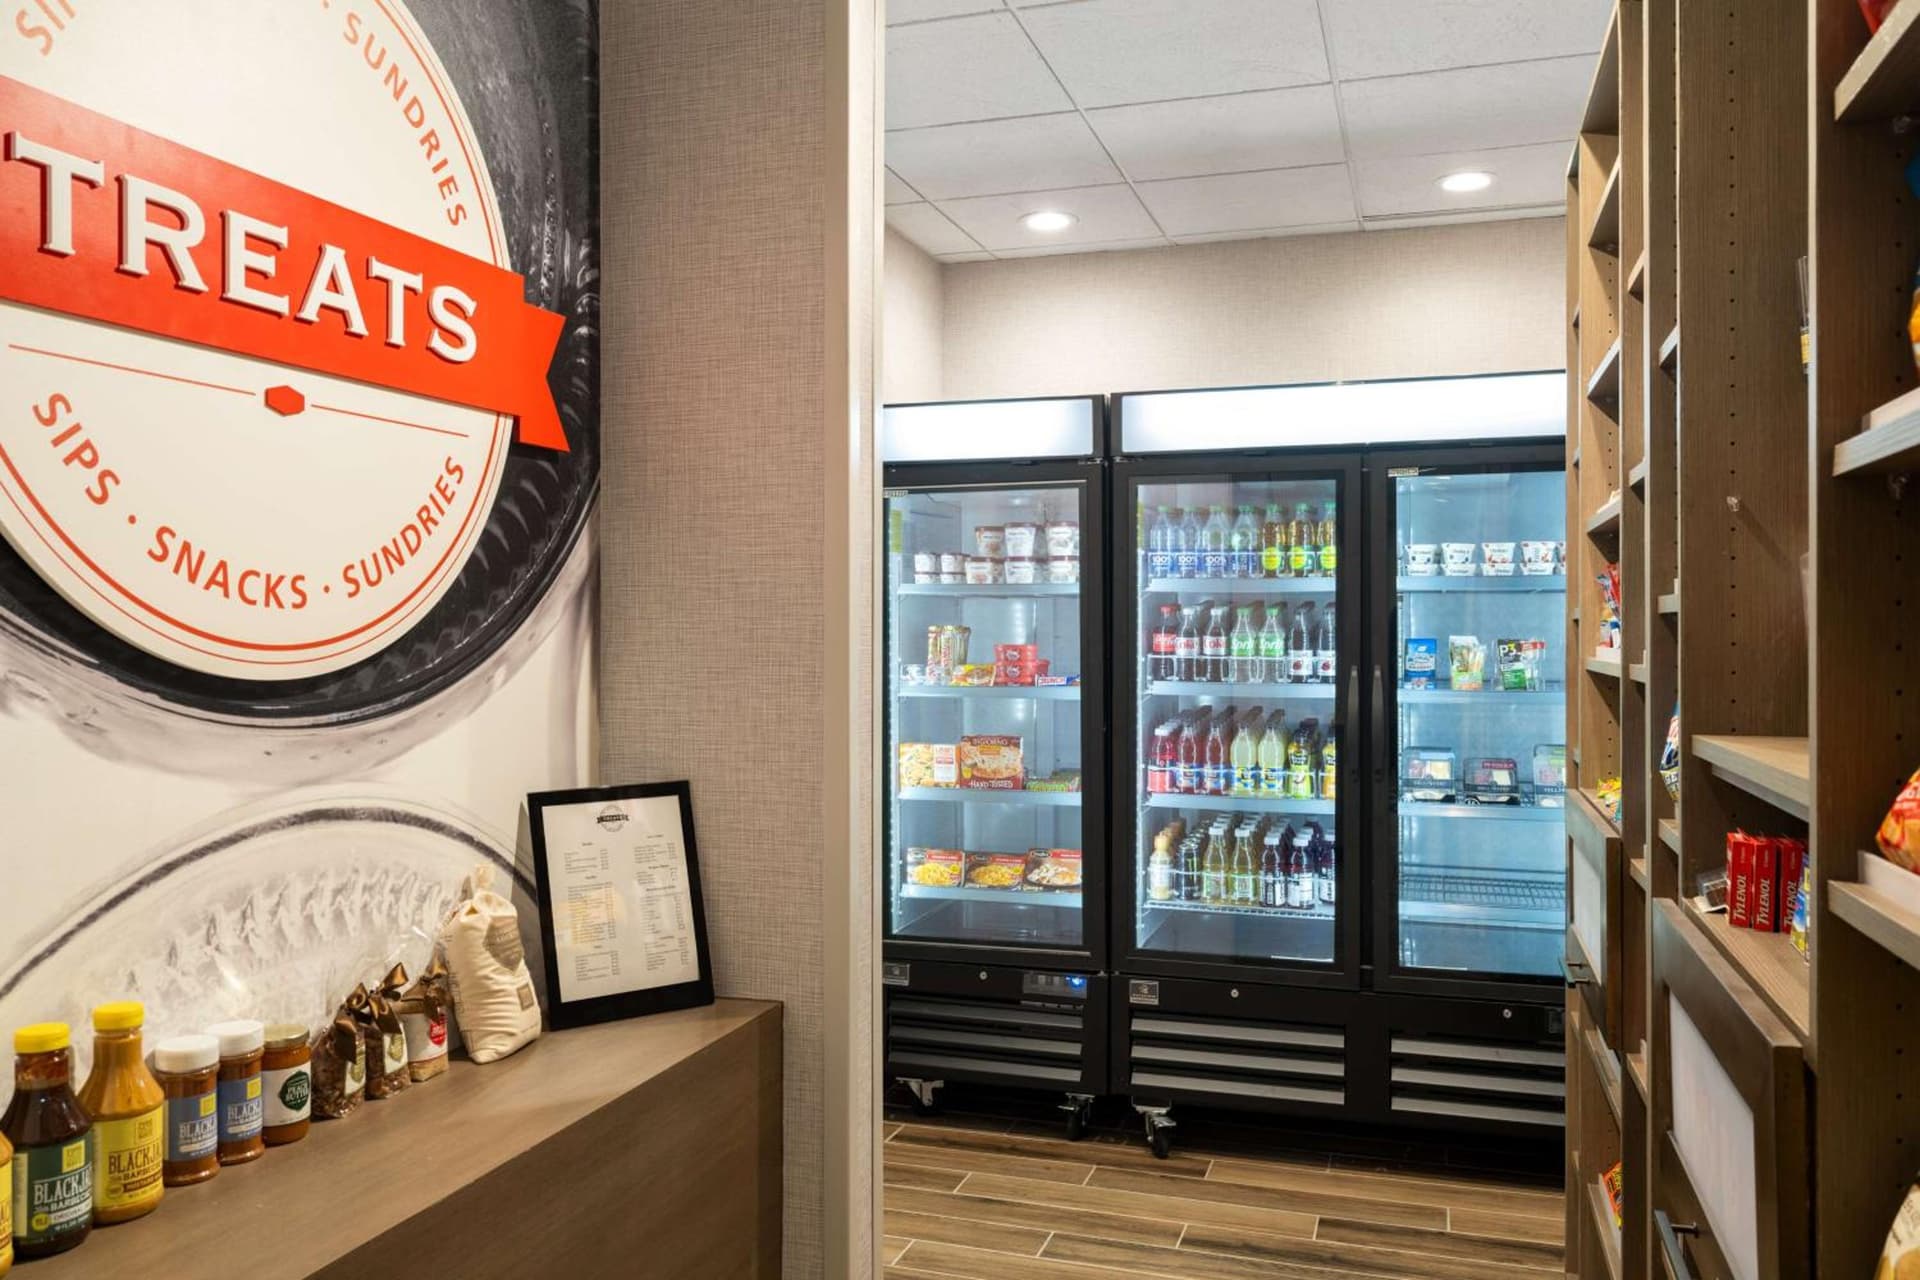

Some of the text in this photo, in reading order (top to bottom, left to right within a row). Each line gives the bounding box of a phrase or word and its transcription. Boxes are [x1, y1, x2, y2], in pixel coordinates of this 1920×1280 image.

[16, 0, 75, 56] SI
[343, 12, 468, 227] SUNDRIES
[7, 131, 478, 363] TREATS
[32, 393, 465, 609] SIPS SNACKS SUNDRIES
[1499, 641, 1517, 657] P3
[1733, 875, 1747, 920] TYLENOL
[1757, 879, 1770, 925] TYLENOL
[1784, 880, 1798, 927] TYLENOL
